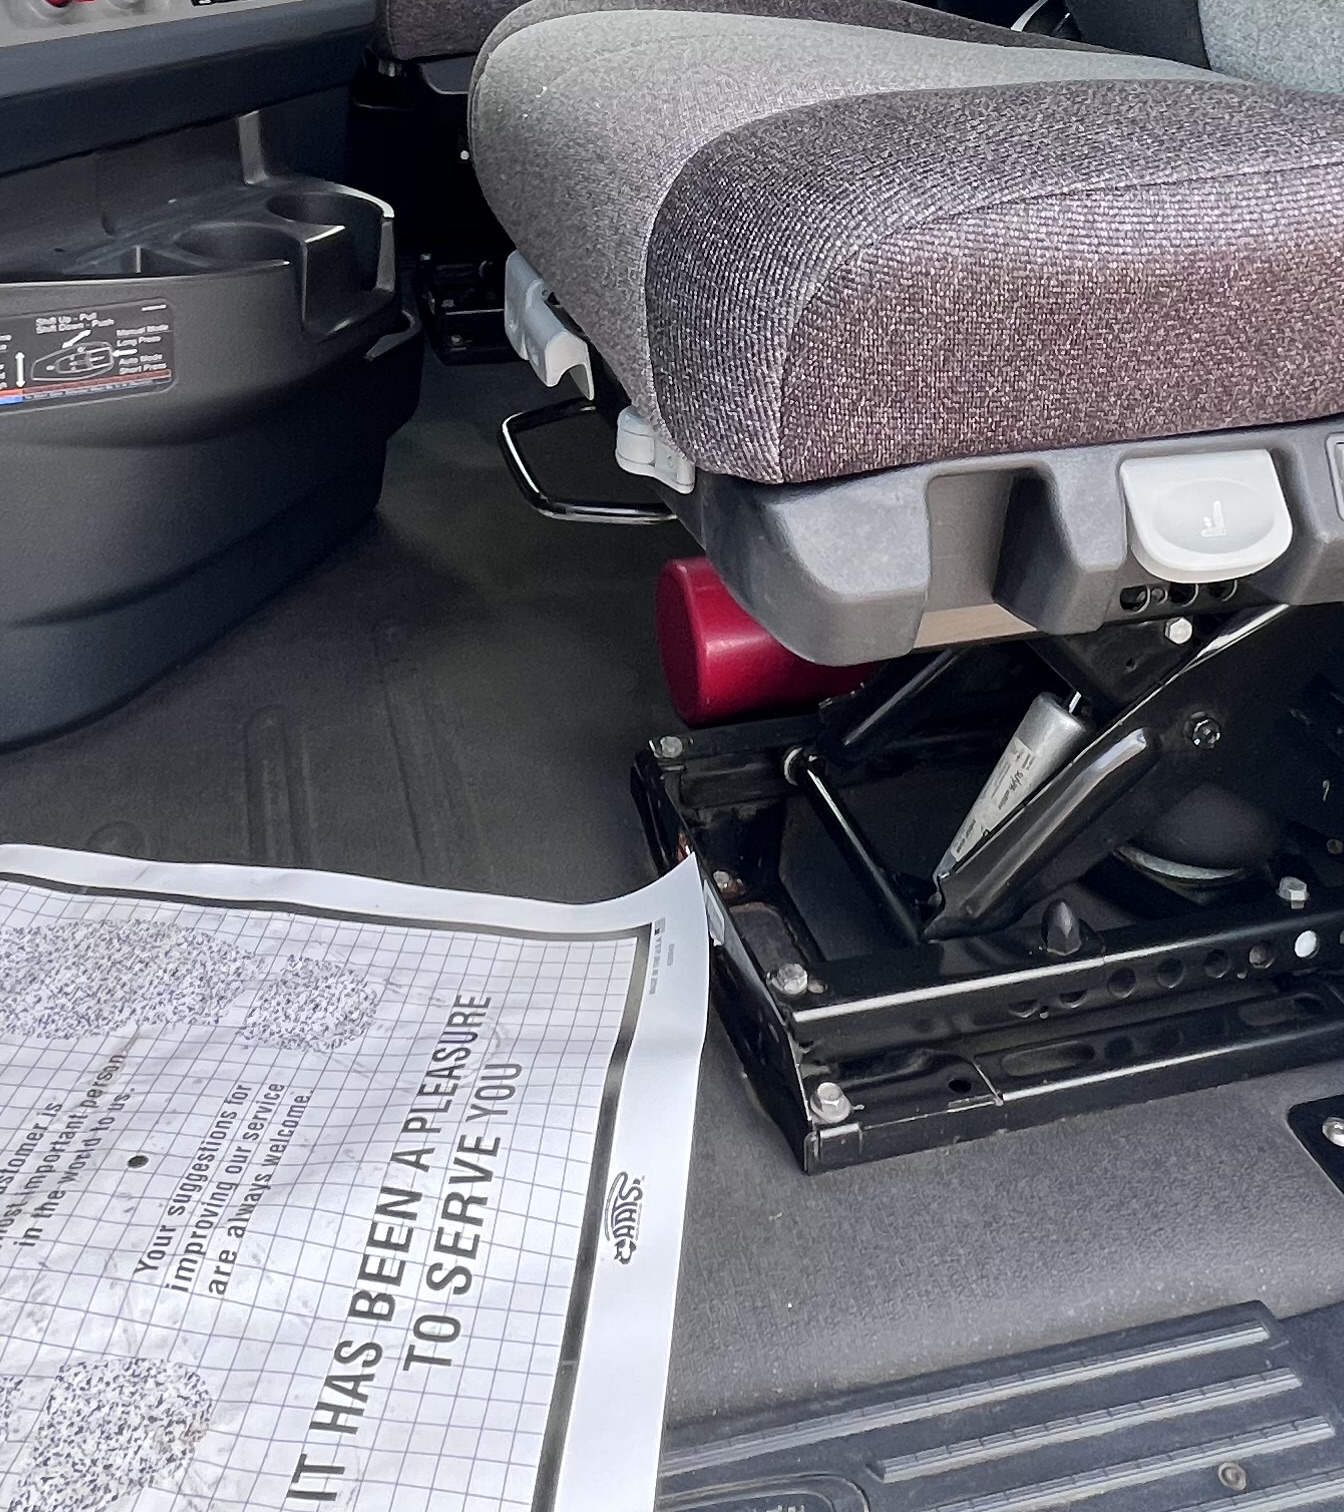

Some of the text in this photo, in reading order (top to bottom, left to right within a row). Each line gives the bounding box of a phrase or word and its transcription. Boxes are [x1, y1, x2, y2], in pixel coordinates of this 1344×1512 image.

[13, 1087, 136, 1247] in the world to us.
[14, 1112, 89, 1196] important
[79, 1053, 127, 1110] person
[36, 1102, 63, 1117] is
[133, 1084, 252, 1275] Your suggestions for
[165, 1083, 285, 1292] improving our service
[208, 1089, 314, 1295] are always welcome.
[286, 993, 492, 1501] IT HAS BEEN A PLEASURE
[402, 1062, 523, 1372] TO SERVE YOU
